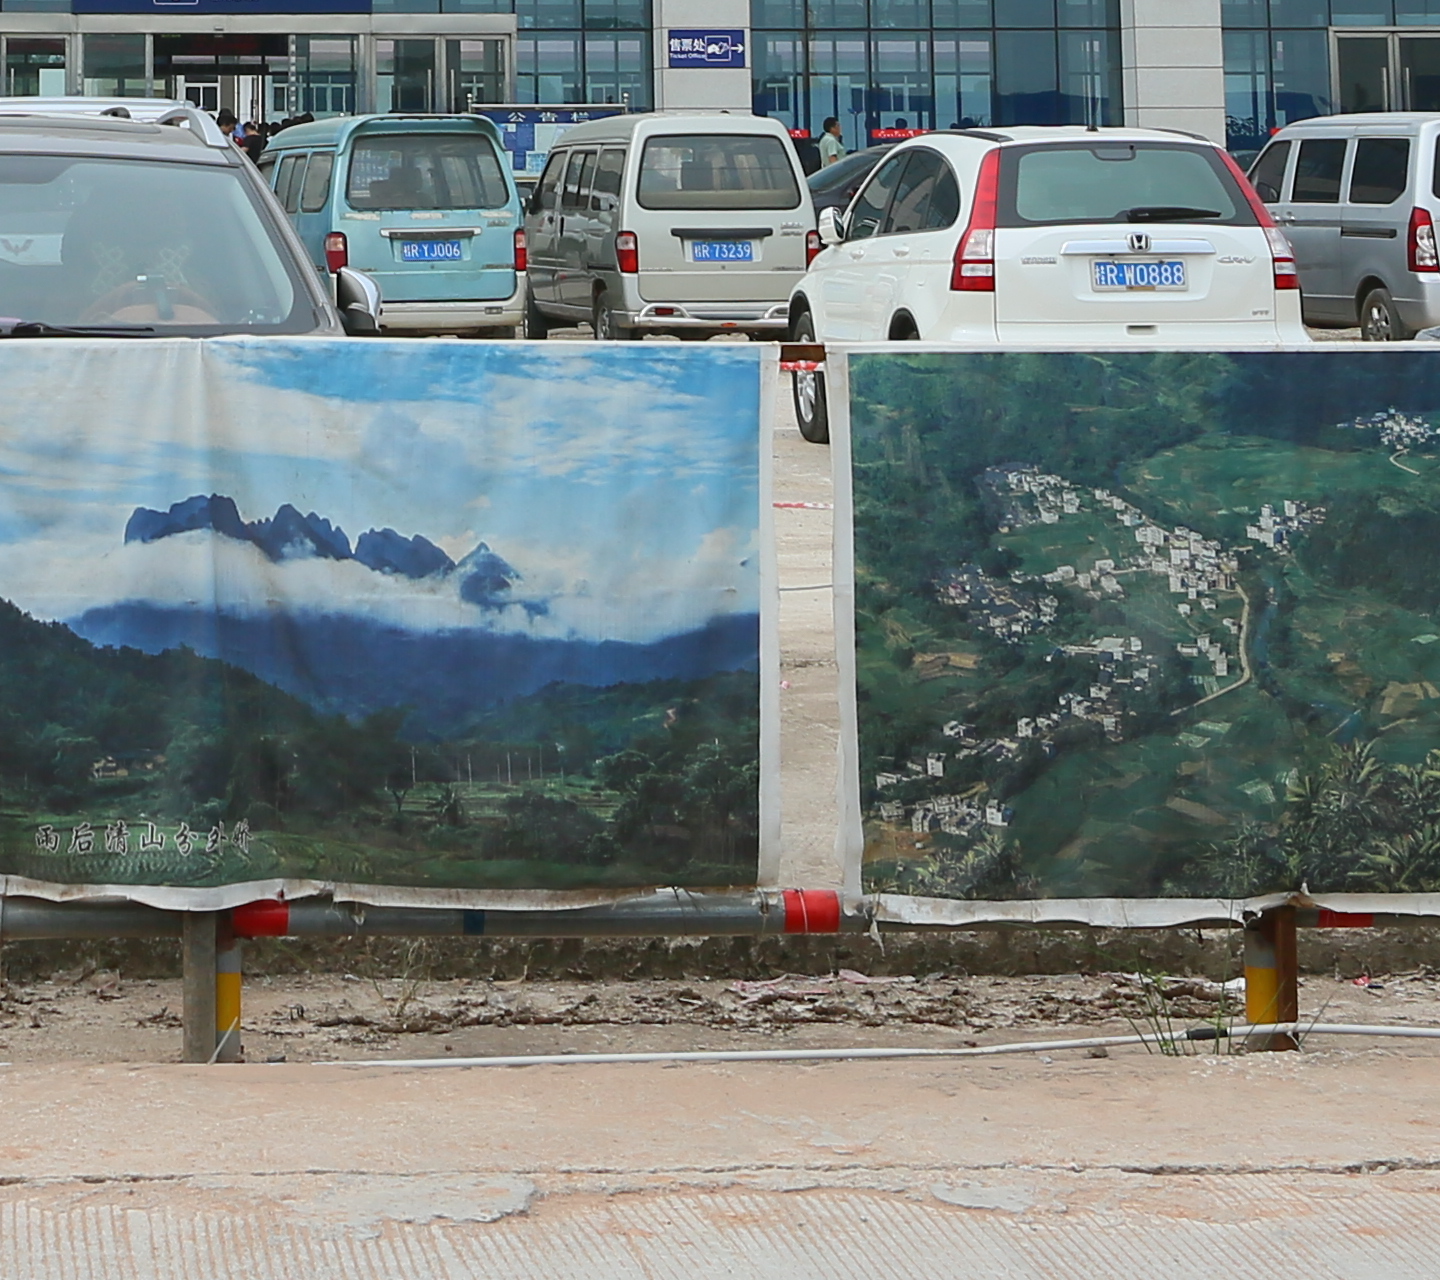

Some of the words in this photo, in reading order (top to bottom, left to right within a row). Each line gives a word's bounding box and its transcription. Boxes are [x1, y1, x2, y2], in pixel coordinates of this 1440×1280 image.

[670, 38, 705, 52] 售票处
[507, 111, 590, 123] 公告栏
